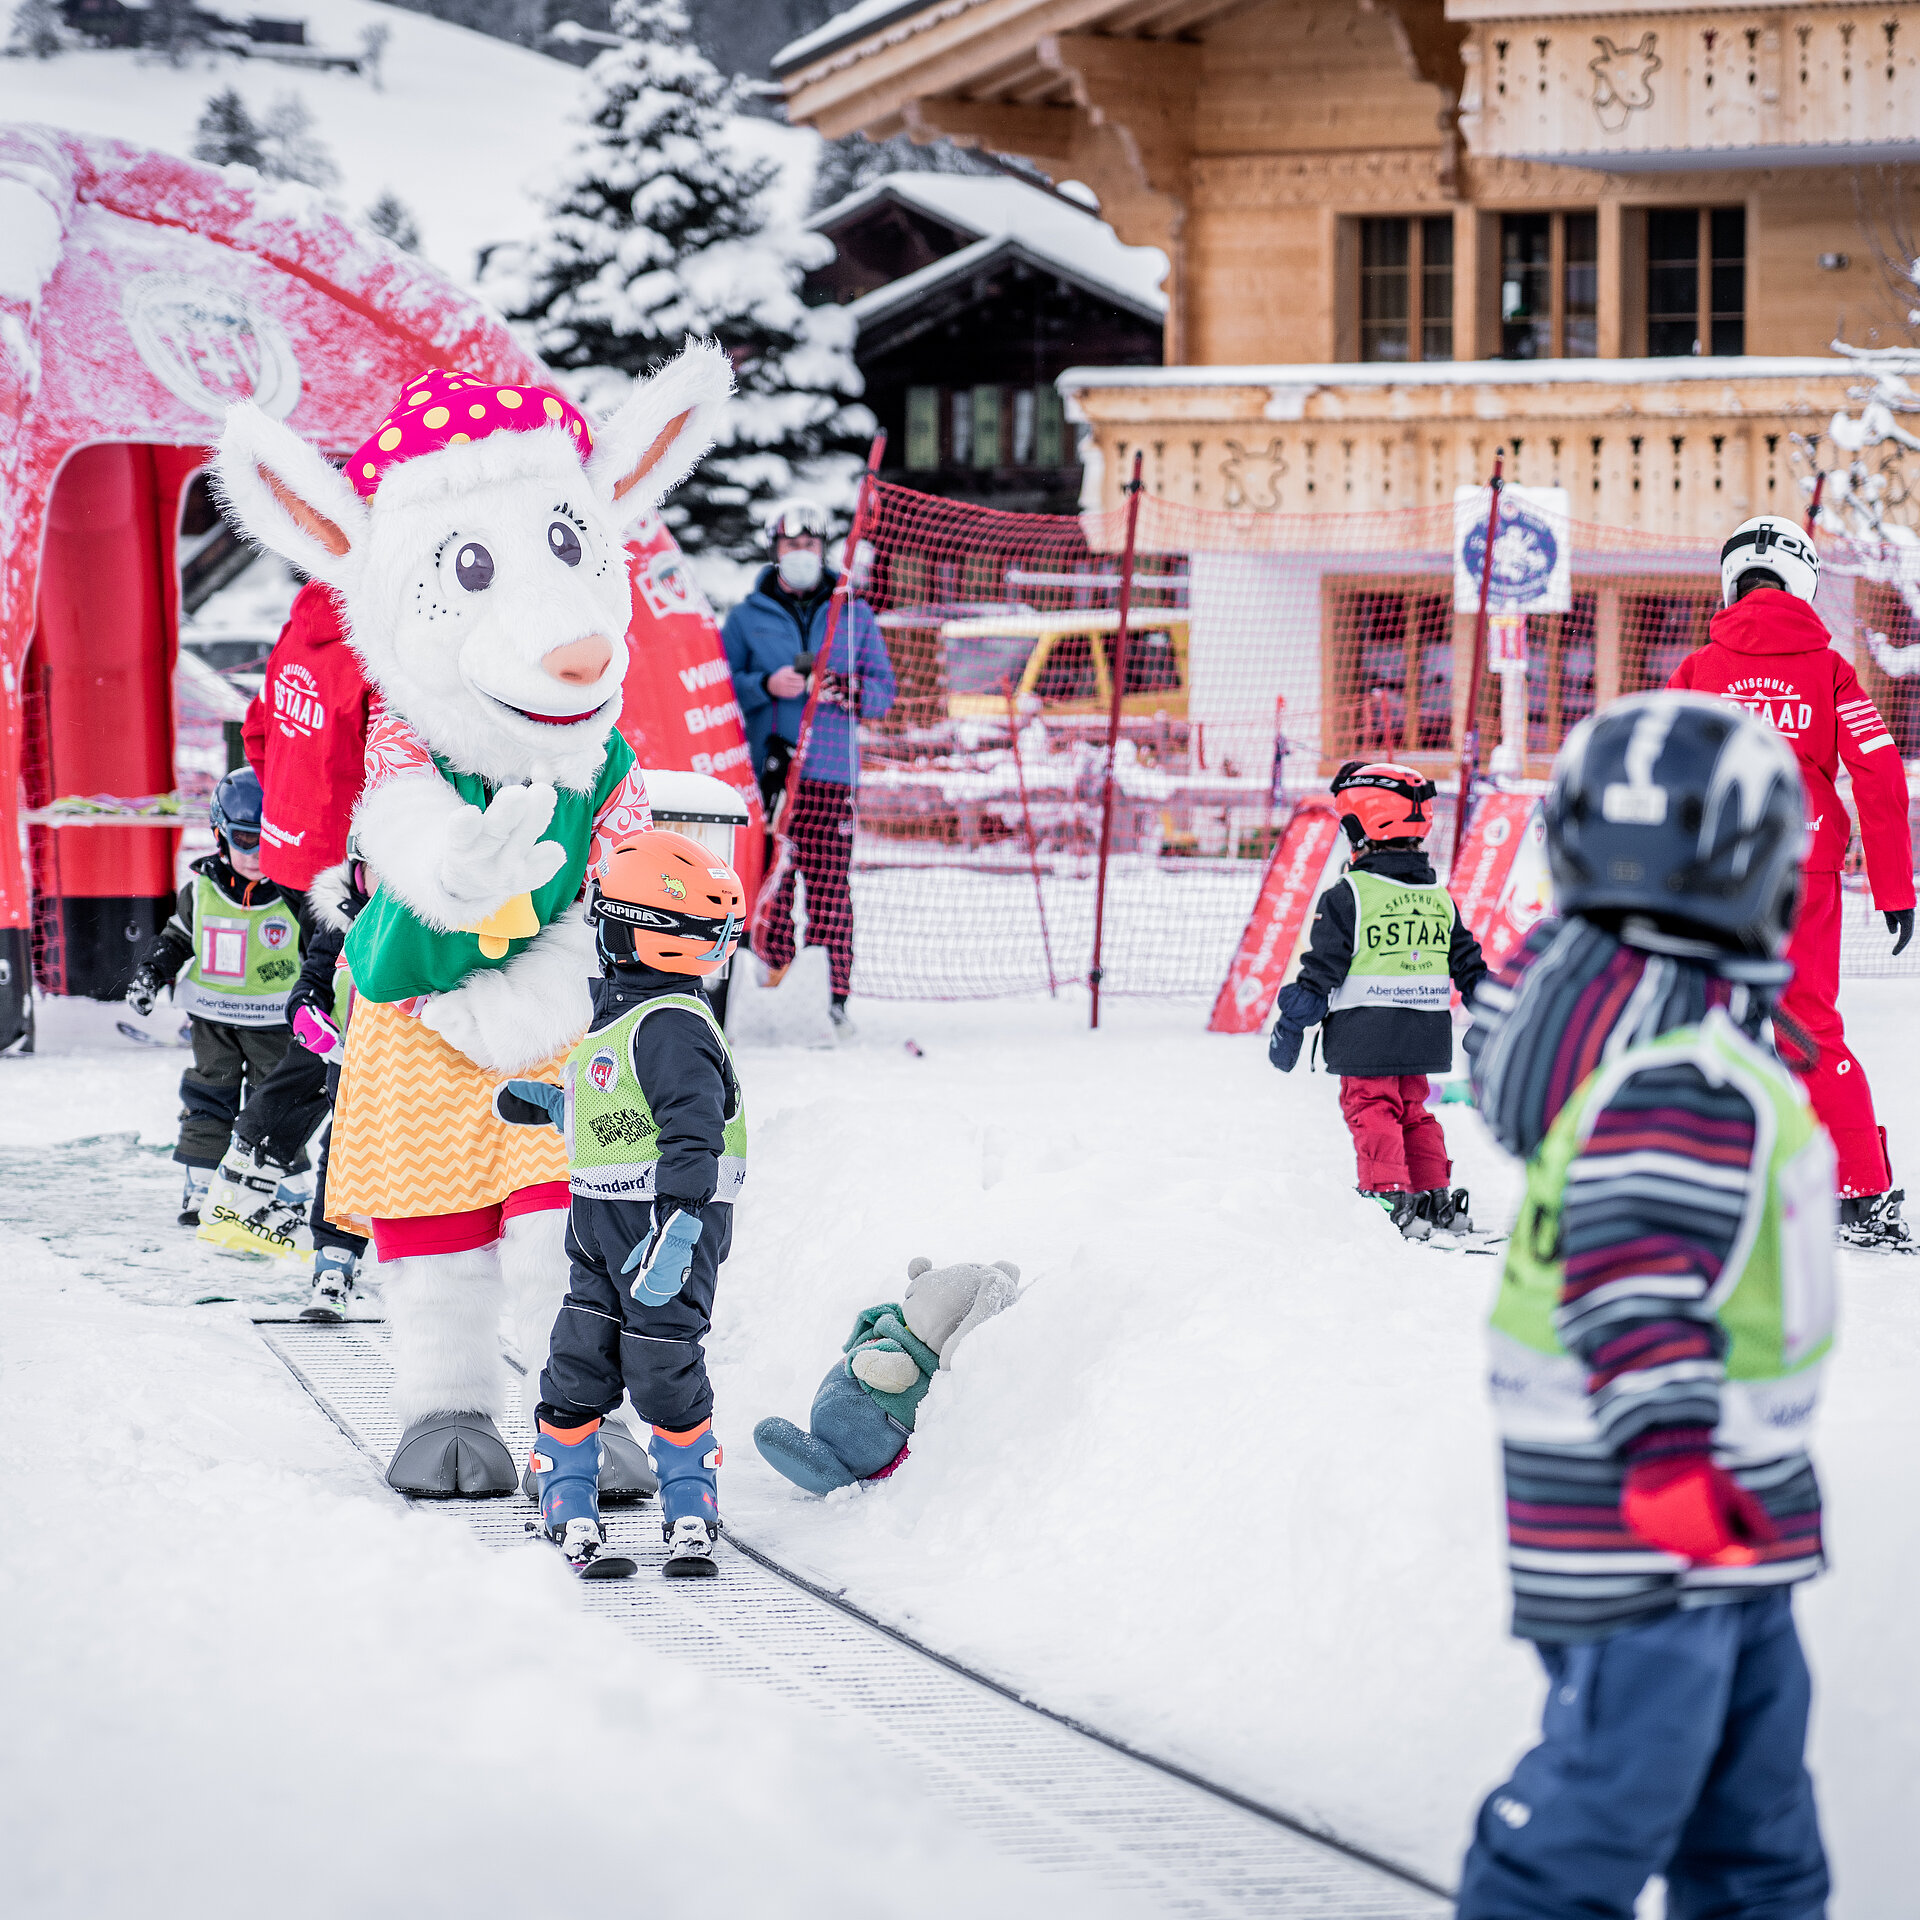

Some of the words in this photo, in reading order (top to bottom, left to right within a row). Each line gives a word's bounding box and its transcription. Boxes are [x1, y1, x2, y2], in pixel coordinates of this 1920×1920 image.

[1727, 677, 1794, 695] SKISCHULE
[274, 679, 324, 730] GSTAAD
[601, 902, 662, 925] ALPINA
[1367, 920, 1451, 949] GSTAA
[593, 1119, 617, 1136] SWISS
[597, 1113, 650, 1148] SNOWSPORT
[623, 1124, 656, 1145] SCHOOL
